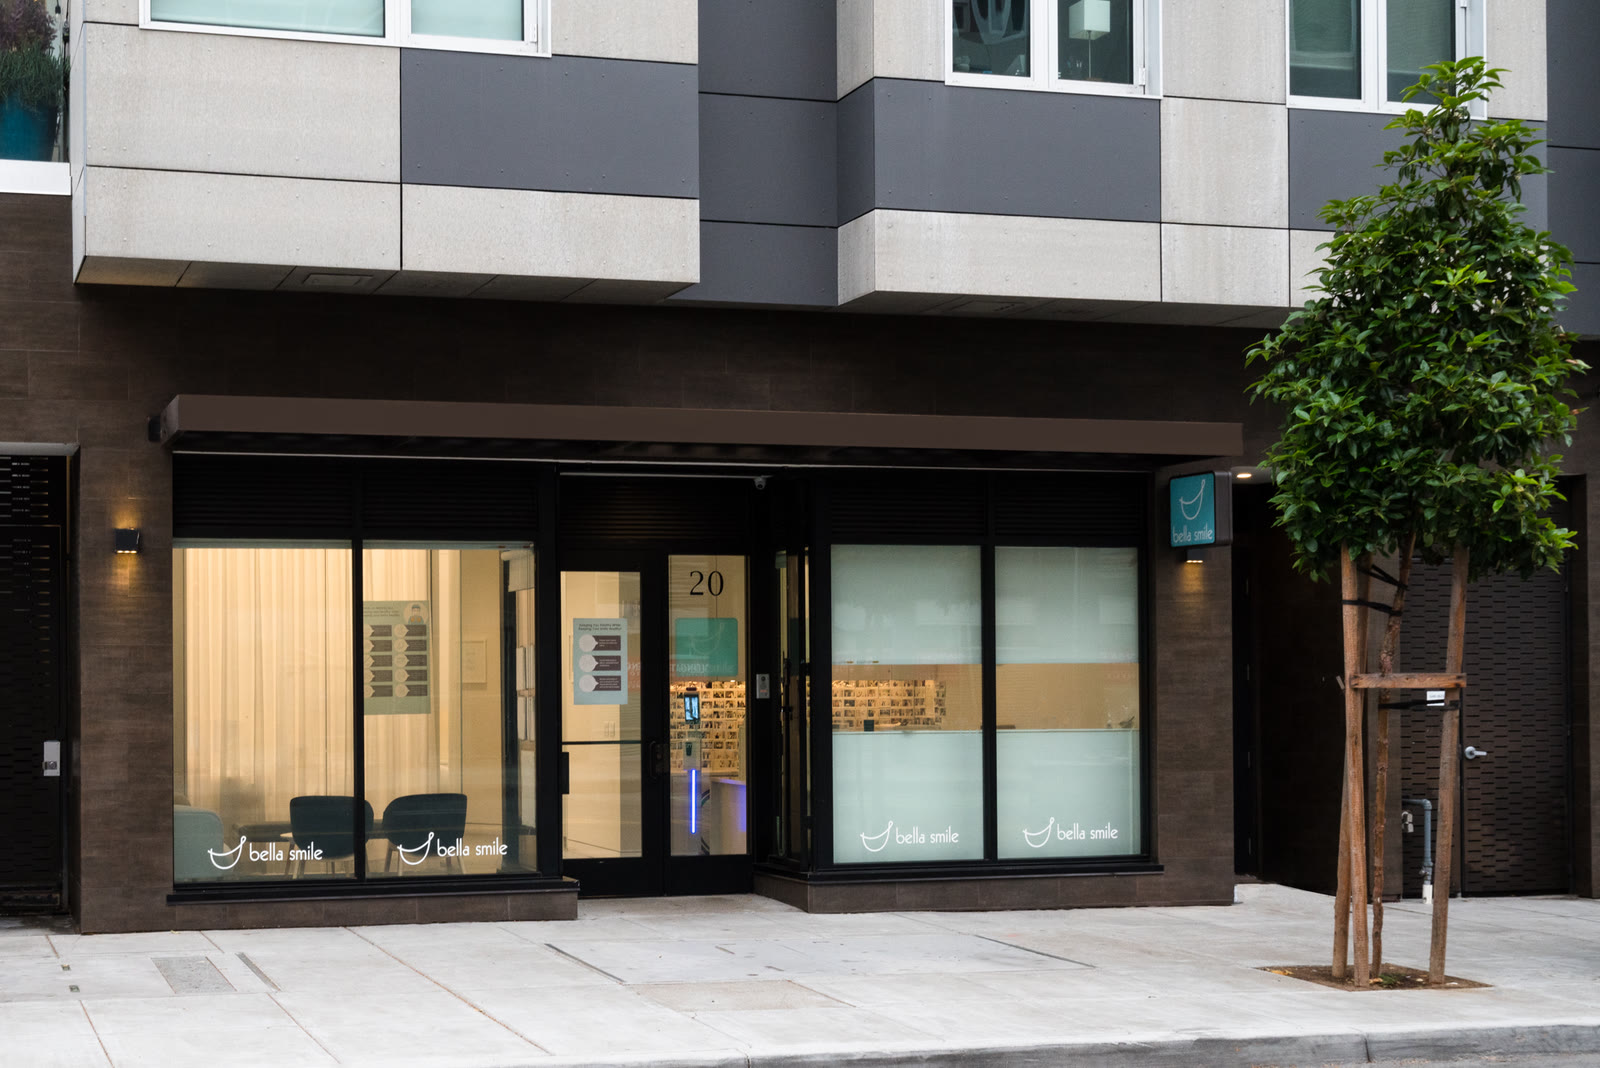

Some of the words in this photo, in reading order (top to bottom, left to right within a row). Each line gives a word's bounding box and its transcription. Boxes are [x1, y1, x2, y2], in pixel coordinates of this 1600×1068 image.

[1172, 525, 1192, 543] bella
[1194, 522, 1213, 541] smile
[689, 570, 724, 596] 20
[895, 826, 925, 844] bella
[930, 825, 959, 843] smile
[1056, 822, 1086, 840] bella
[1090, 821, 1118, 839] smile
[249, 842, 284, 862] bella
[289, 841, 323, 861] smile
[437, 838, 470, 857] bella
[475, 836, 508, 856] smile
